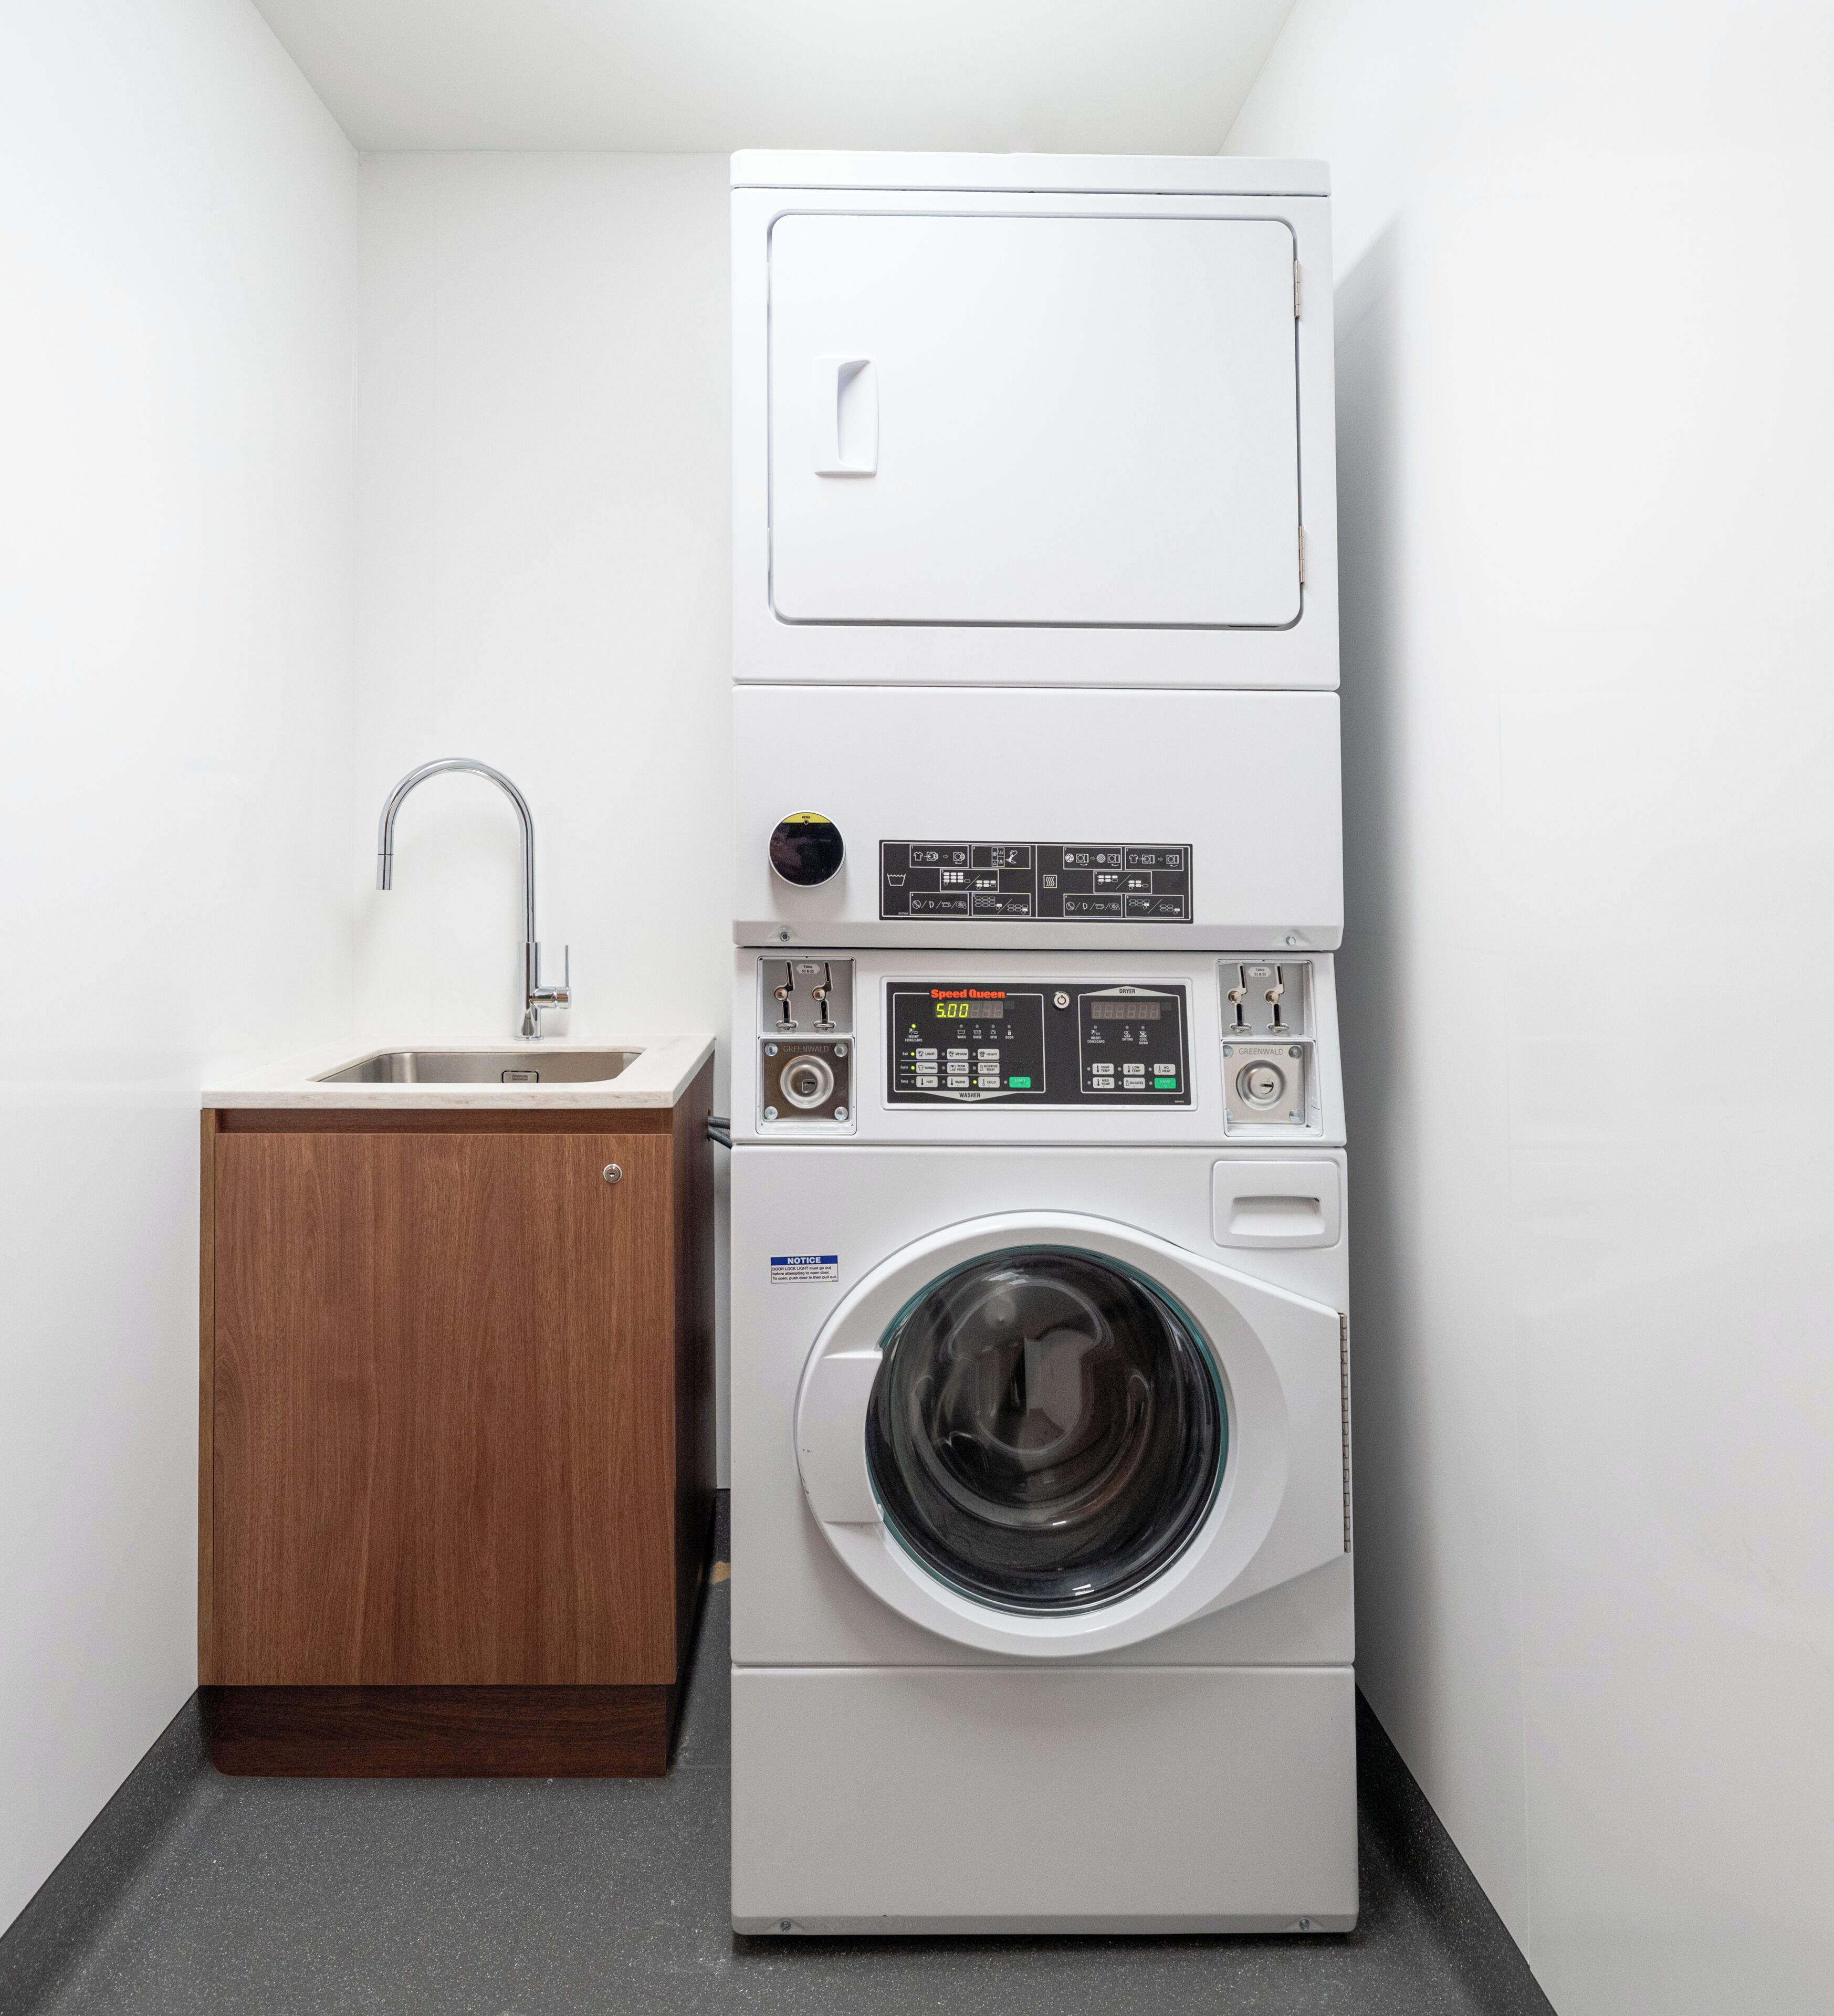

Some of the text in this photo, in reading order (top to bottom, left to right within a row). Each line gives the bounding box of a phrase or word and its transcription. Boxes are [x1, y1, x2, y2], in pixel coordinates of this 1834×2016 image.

[931, 989, 1005, 1000] Speed Queen
[937, 1003, 969, 1017] 5.00
